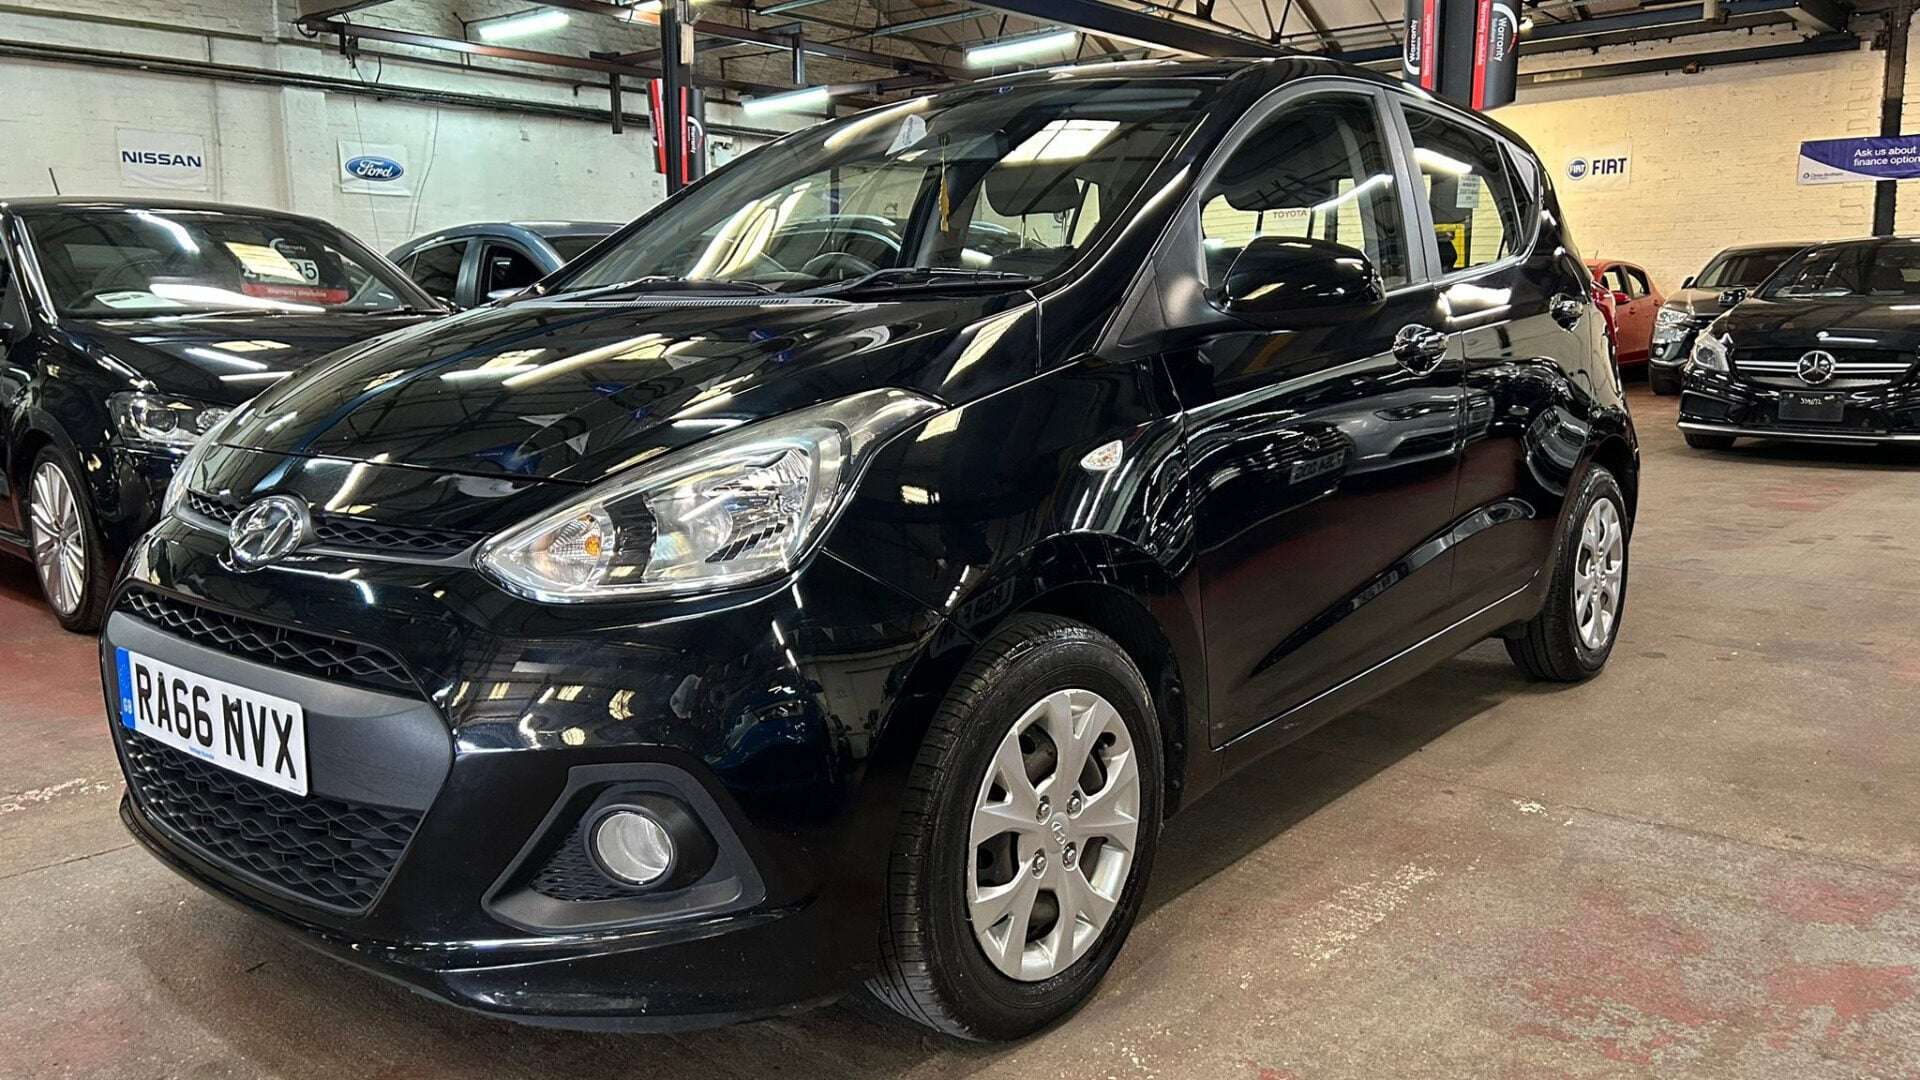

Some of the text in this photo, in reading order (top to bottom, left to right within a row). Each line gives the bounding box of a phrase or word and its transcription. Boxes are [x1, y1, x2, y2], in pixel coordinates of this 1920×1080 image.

[1408, 19, 1418, 62] Warranty
[1494, 17, 1507, 61] Warranty
[122, 151, 202, 167] NISSAN
[1854, 146, 1917, 157] Ask us about
[356, 160, 394, 177] Ford
[1592, 158, 1627, 175] FIAT
[1853, 156, 1888, 166] finance
[1273, 210, 1307, 218] TOYOTA
[135, 663, 297, 780] RA66 NVX
